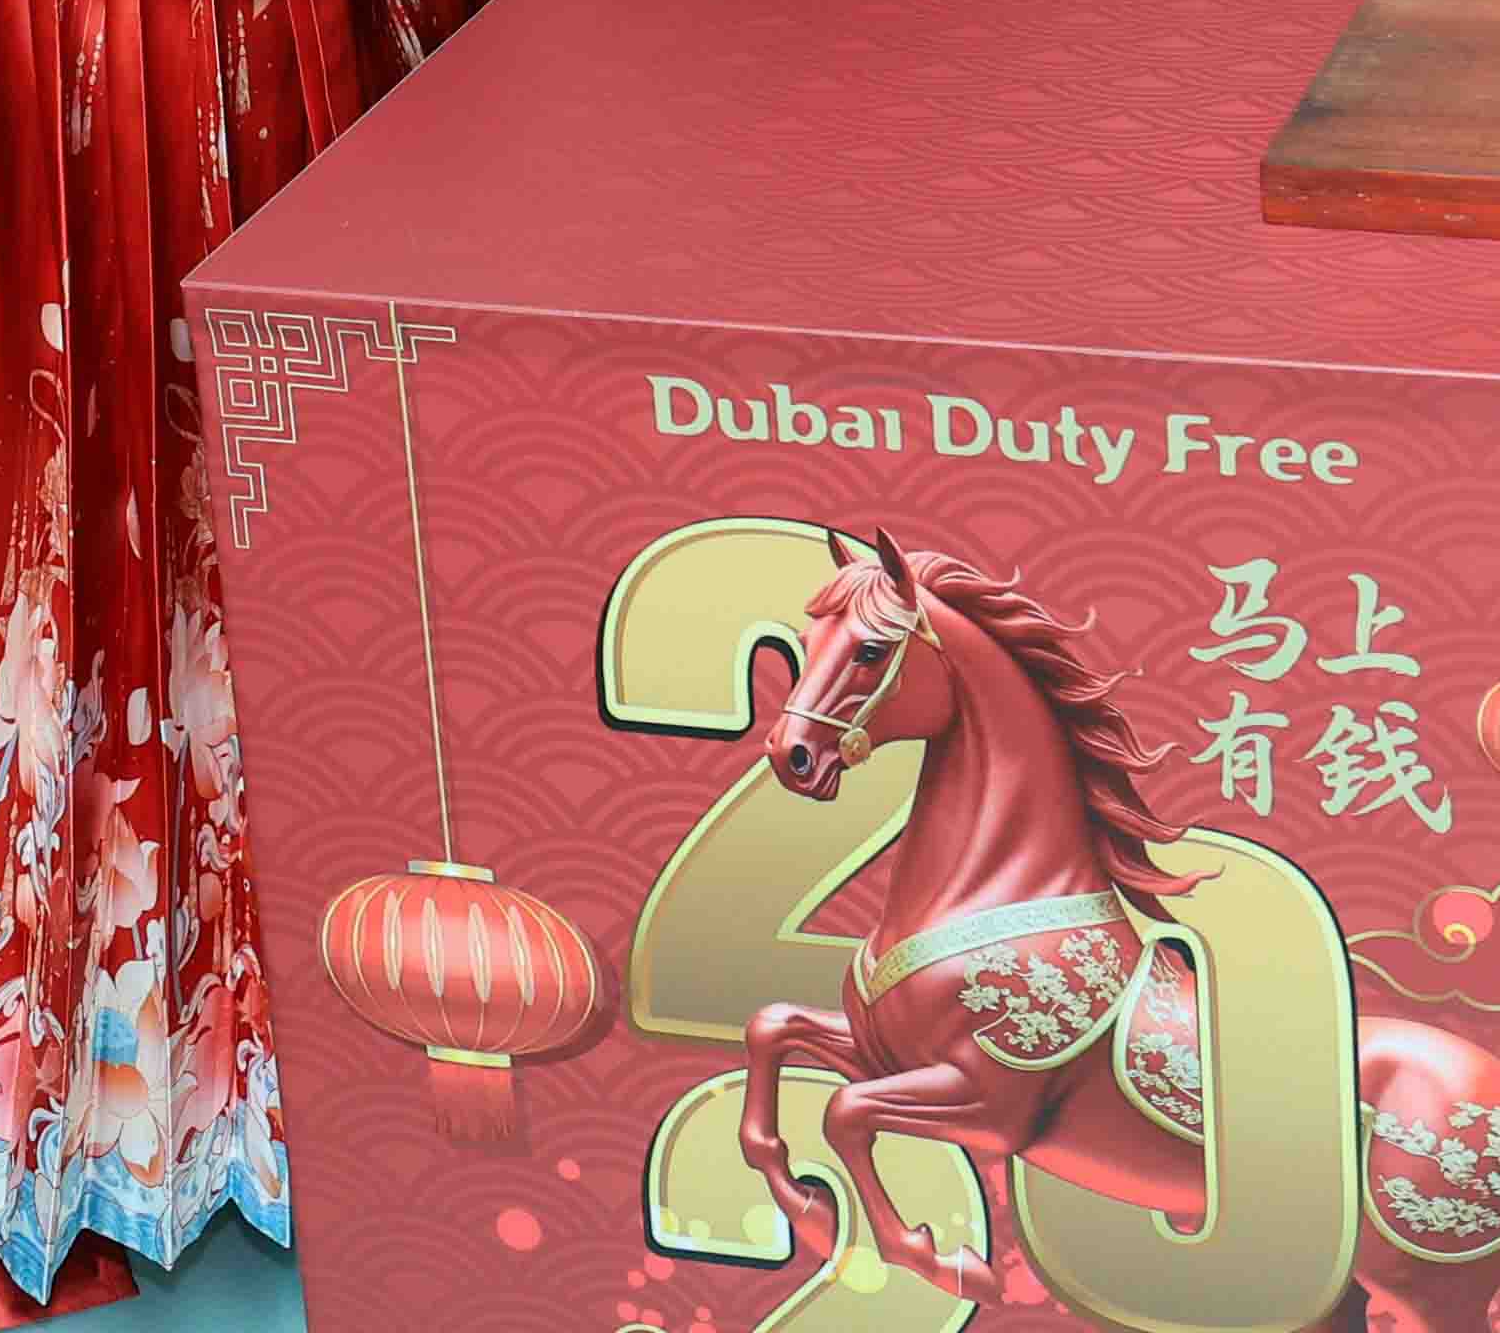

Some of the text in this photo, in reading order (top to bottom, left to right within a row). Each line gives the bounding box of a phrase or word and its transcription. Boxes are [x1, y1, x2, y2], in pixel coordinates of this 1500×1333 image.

[645, 374, 1360, 485] Dubai Duty Free
[1187, 557, 1422, 683] 马上
